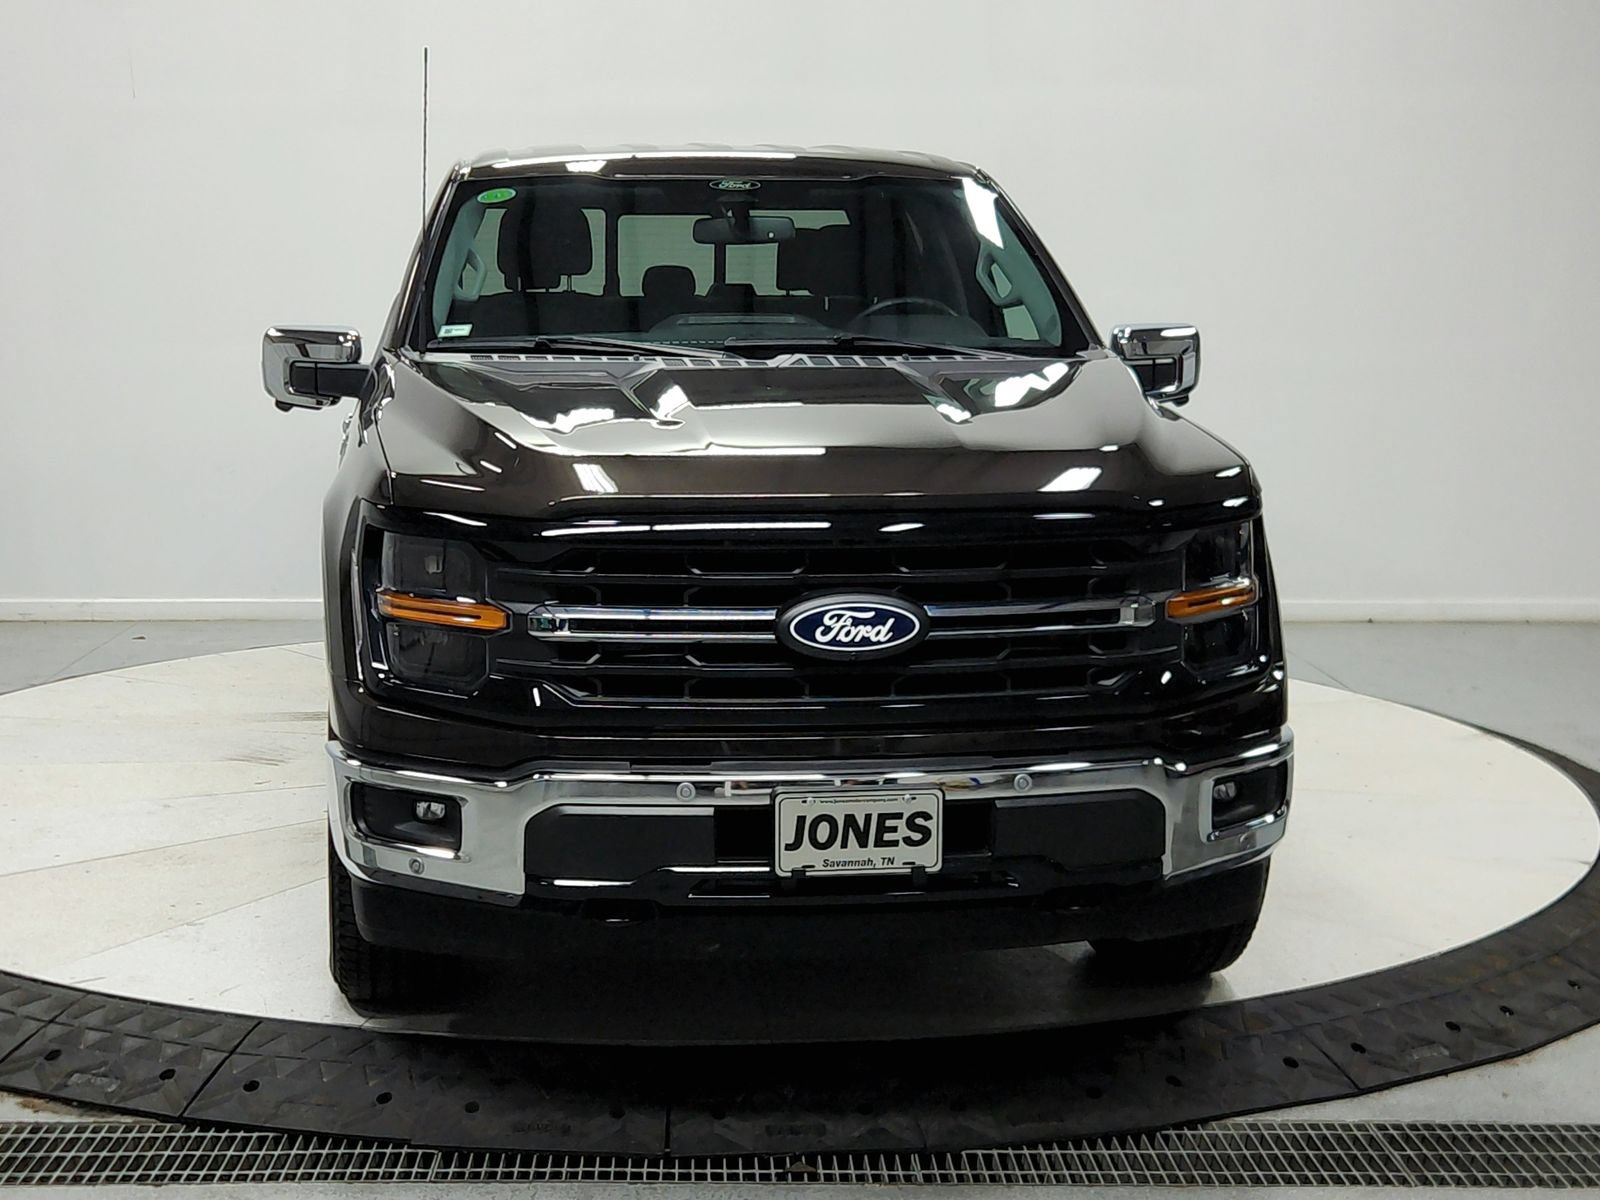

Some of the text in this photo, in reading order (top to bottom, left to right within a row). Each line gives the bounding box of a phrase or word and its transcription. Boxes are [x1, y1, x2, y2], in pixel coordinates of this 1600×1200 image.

[719, 180, 752, 189] Ford
[815, 609, 895, 643] Ford
[784, 811, 934, 852] JONES
[822, 857, 896, 869] Savannah, TN
